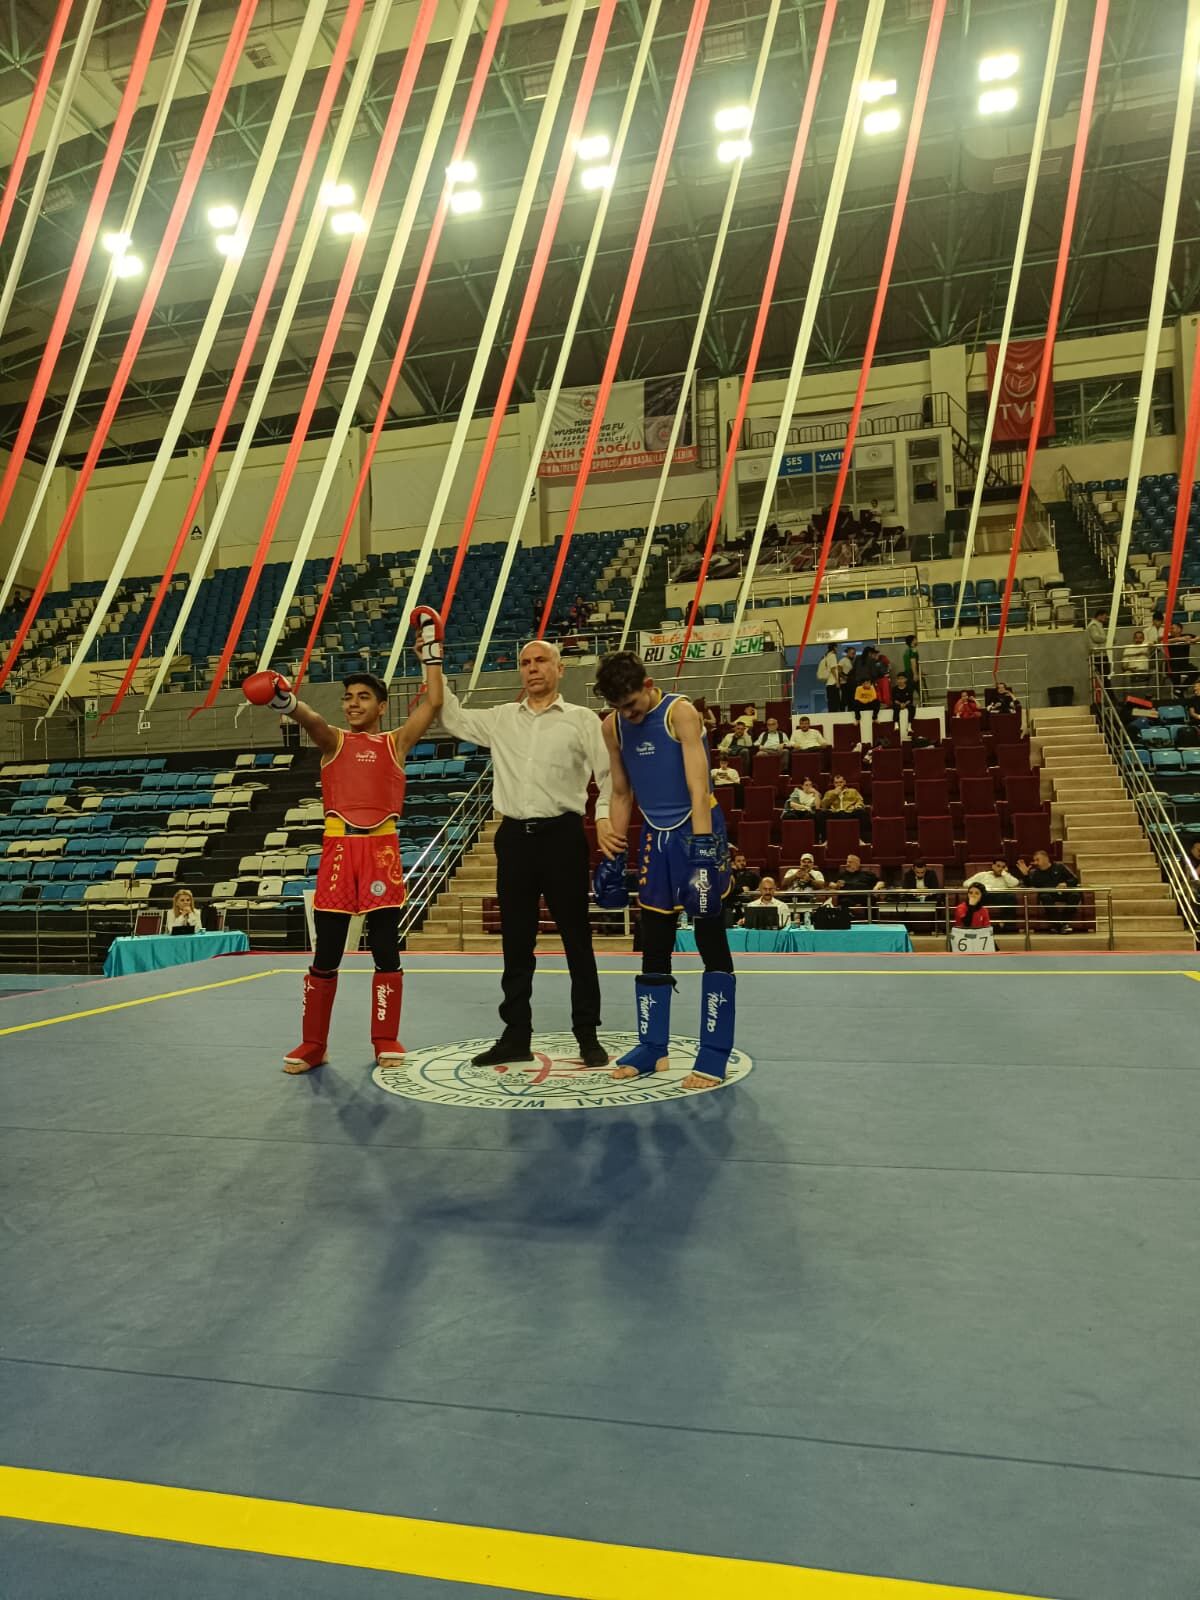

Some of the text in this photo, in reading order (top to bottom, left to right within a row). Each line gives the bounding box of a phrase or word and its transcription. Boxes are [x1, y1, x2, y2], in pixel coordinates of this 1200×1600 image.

[785, 456, 803, 466] SES
[191, 525, 202, 535] A
[644, 647, 664, 662] BU
[699, 888, 708, 913] FIGHT
[958, 936, 988, 952] 6 7
[435, 1093, 545, 1109] WUSHU
